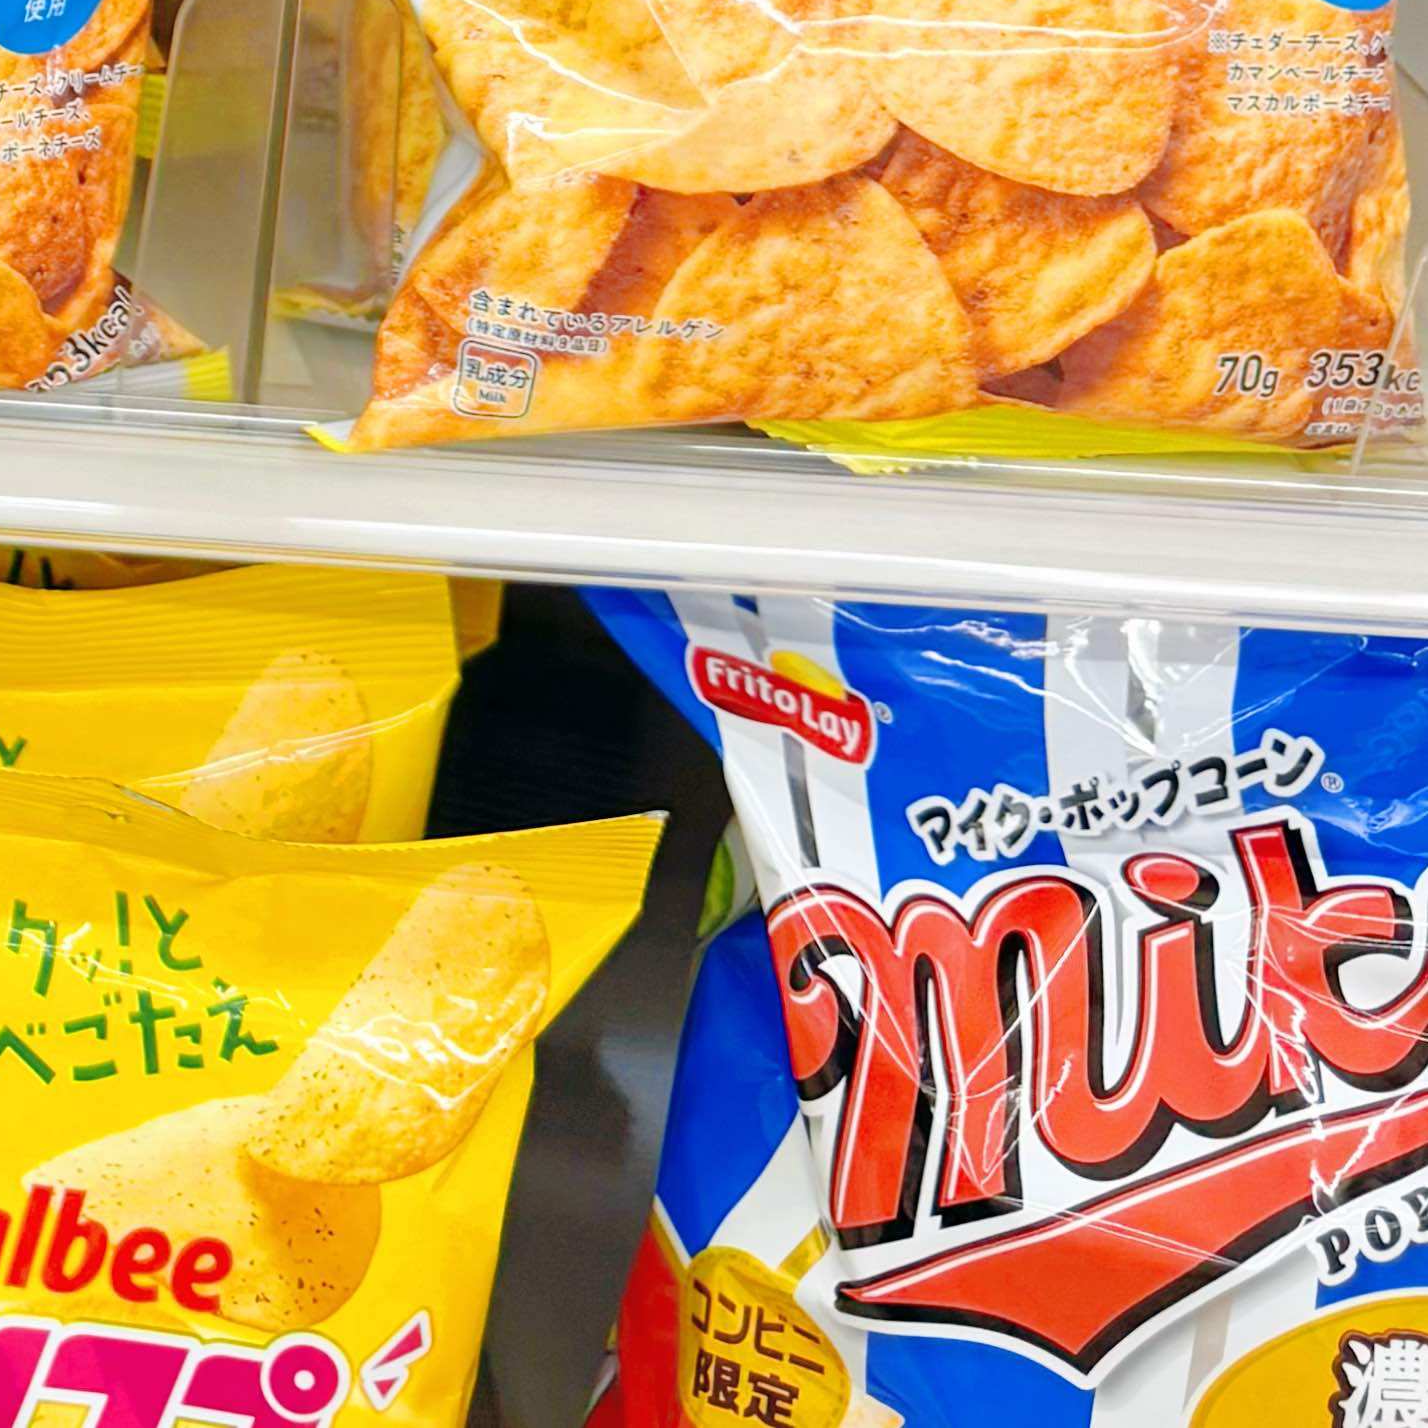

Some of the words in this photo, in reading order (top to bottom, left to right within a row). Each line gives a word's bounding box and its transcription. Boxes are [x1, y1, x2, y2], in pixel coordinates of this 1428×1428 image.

[470, 288, 726, 341] 含まれているアレルゲン
[464, 356, 531, 390] 乳成分
[1215, 353, 1280, 399] 70g
[690, 1276, 827, 1374] コンビニ
[692, 1350, 801, 1428] 限定
